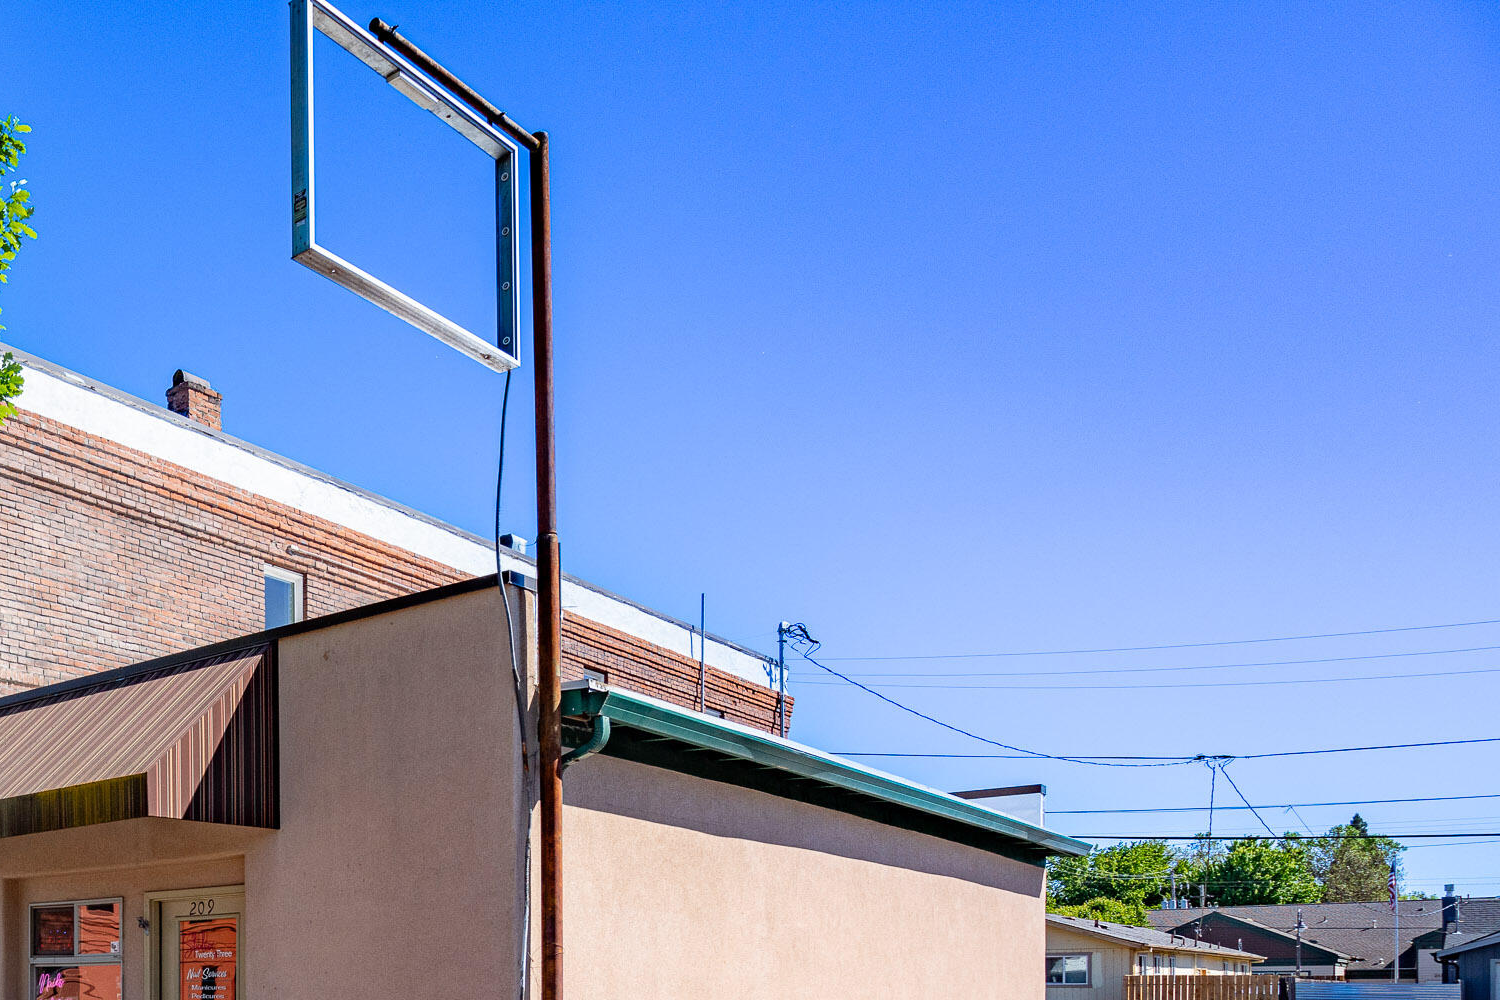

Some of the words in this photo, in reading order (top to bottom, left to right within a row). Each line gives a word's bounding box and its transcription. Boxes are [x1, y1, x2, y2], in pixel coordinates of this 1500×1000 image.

[189, 899, 215, 916] 209
[194, 950, 215, 960] Twenty
[216, 949, 233, 958] Three
[186, 968, 201, 980] Nail
[202, 967, 228, 980] Services
